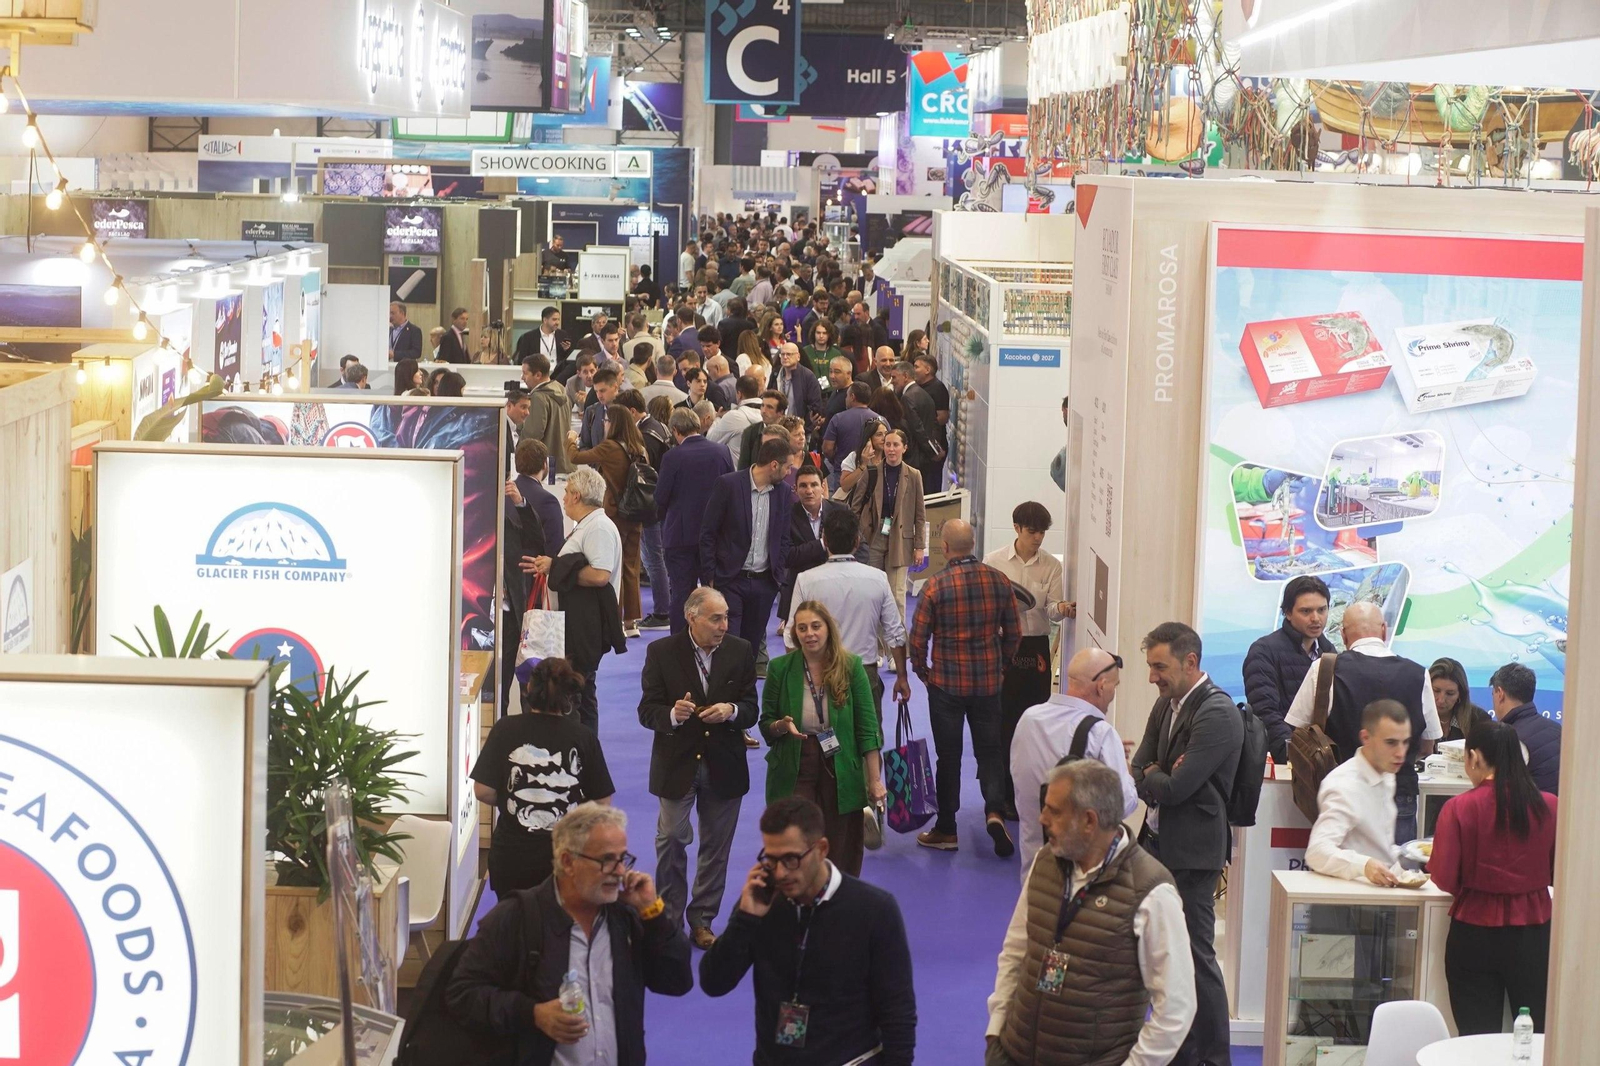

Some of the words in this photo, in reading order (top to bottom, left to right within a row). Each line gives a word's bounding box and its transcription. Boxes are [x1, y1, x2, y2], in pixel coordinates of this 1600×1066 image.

[773, 0, 791, 15] 4
[726, 25, 780, 96] C
[847, 69, 882, 84] Hall
[886, 70, 896, 84] 5
[480, 156, 607, 171] SHOWCOOKING
[94, 219, 144, 230] ederPesca
[245, 228, 275, 236] ederPesca
[386, 226, 438, 237] ederPesca
[1154, 243, 1179, 402] PROMAROSA
[1418, 343, 1442, 352] Prime
[1443, 340, 1471, 349] Shrimp
[196, 567, 248, 579] GLACIER
[253, 569, 280, 580] FISH
[284, 570, 346, 582] COMPANY
